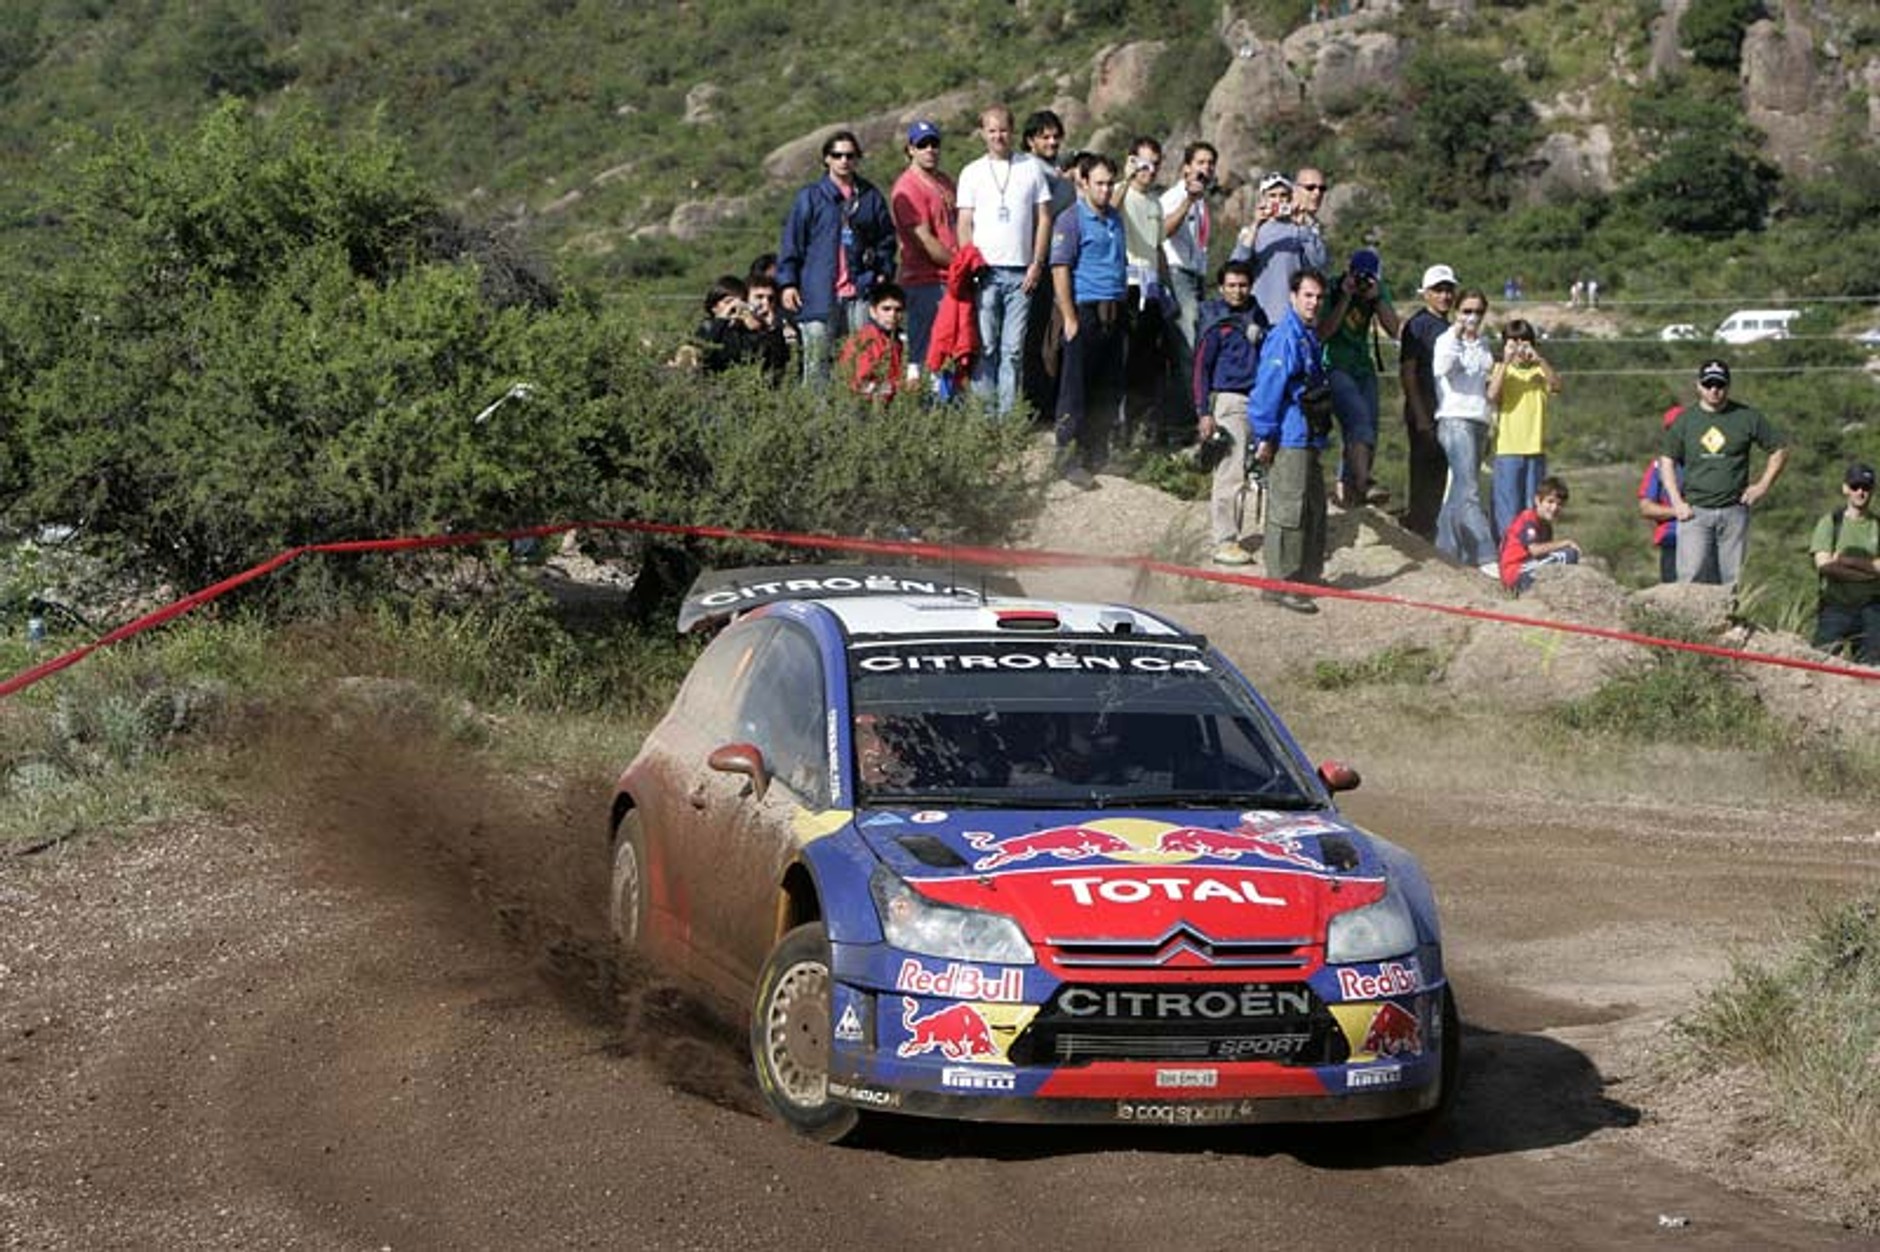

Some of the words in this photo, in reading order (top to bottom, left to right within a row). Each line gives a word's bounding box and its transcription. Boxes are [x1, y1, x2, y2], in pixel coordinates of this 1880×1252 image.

[700, 575, 935, 606] CITROËN
[859, 652, 1120, 671] CITROËN
[1130, 657, 1211, 672] C4
[1051, 877, 1288, 905] TOTAL
[896, 959, 959, 995] Red
[959, 965, 1023, 1002] Bull
[1338, 963, 1390, 1000] Red
[1057, 984, 1310, 1018] CITROËN
[1218, 1036, 1310, 1055] SPORT
[1135, 1105, 1174, 1124] coq
